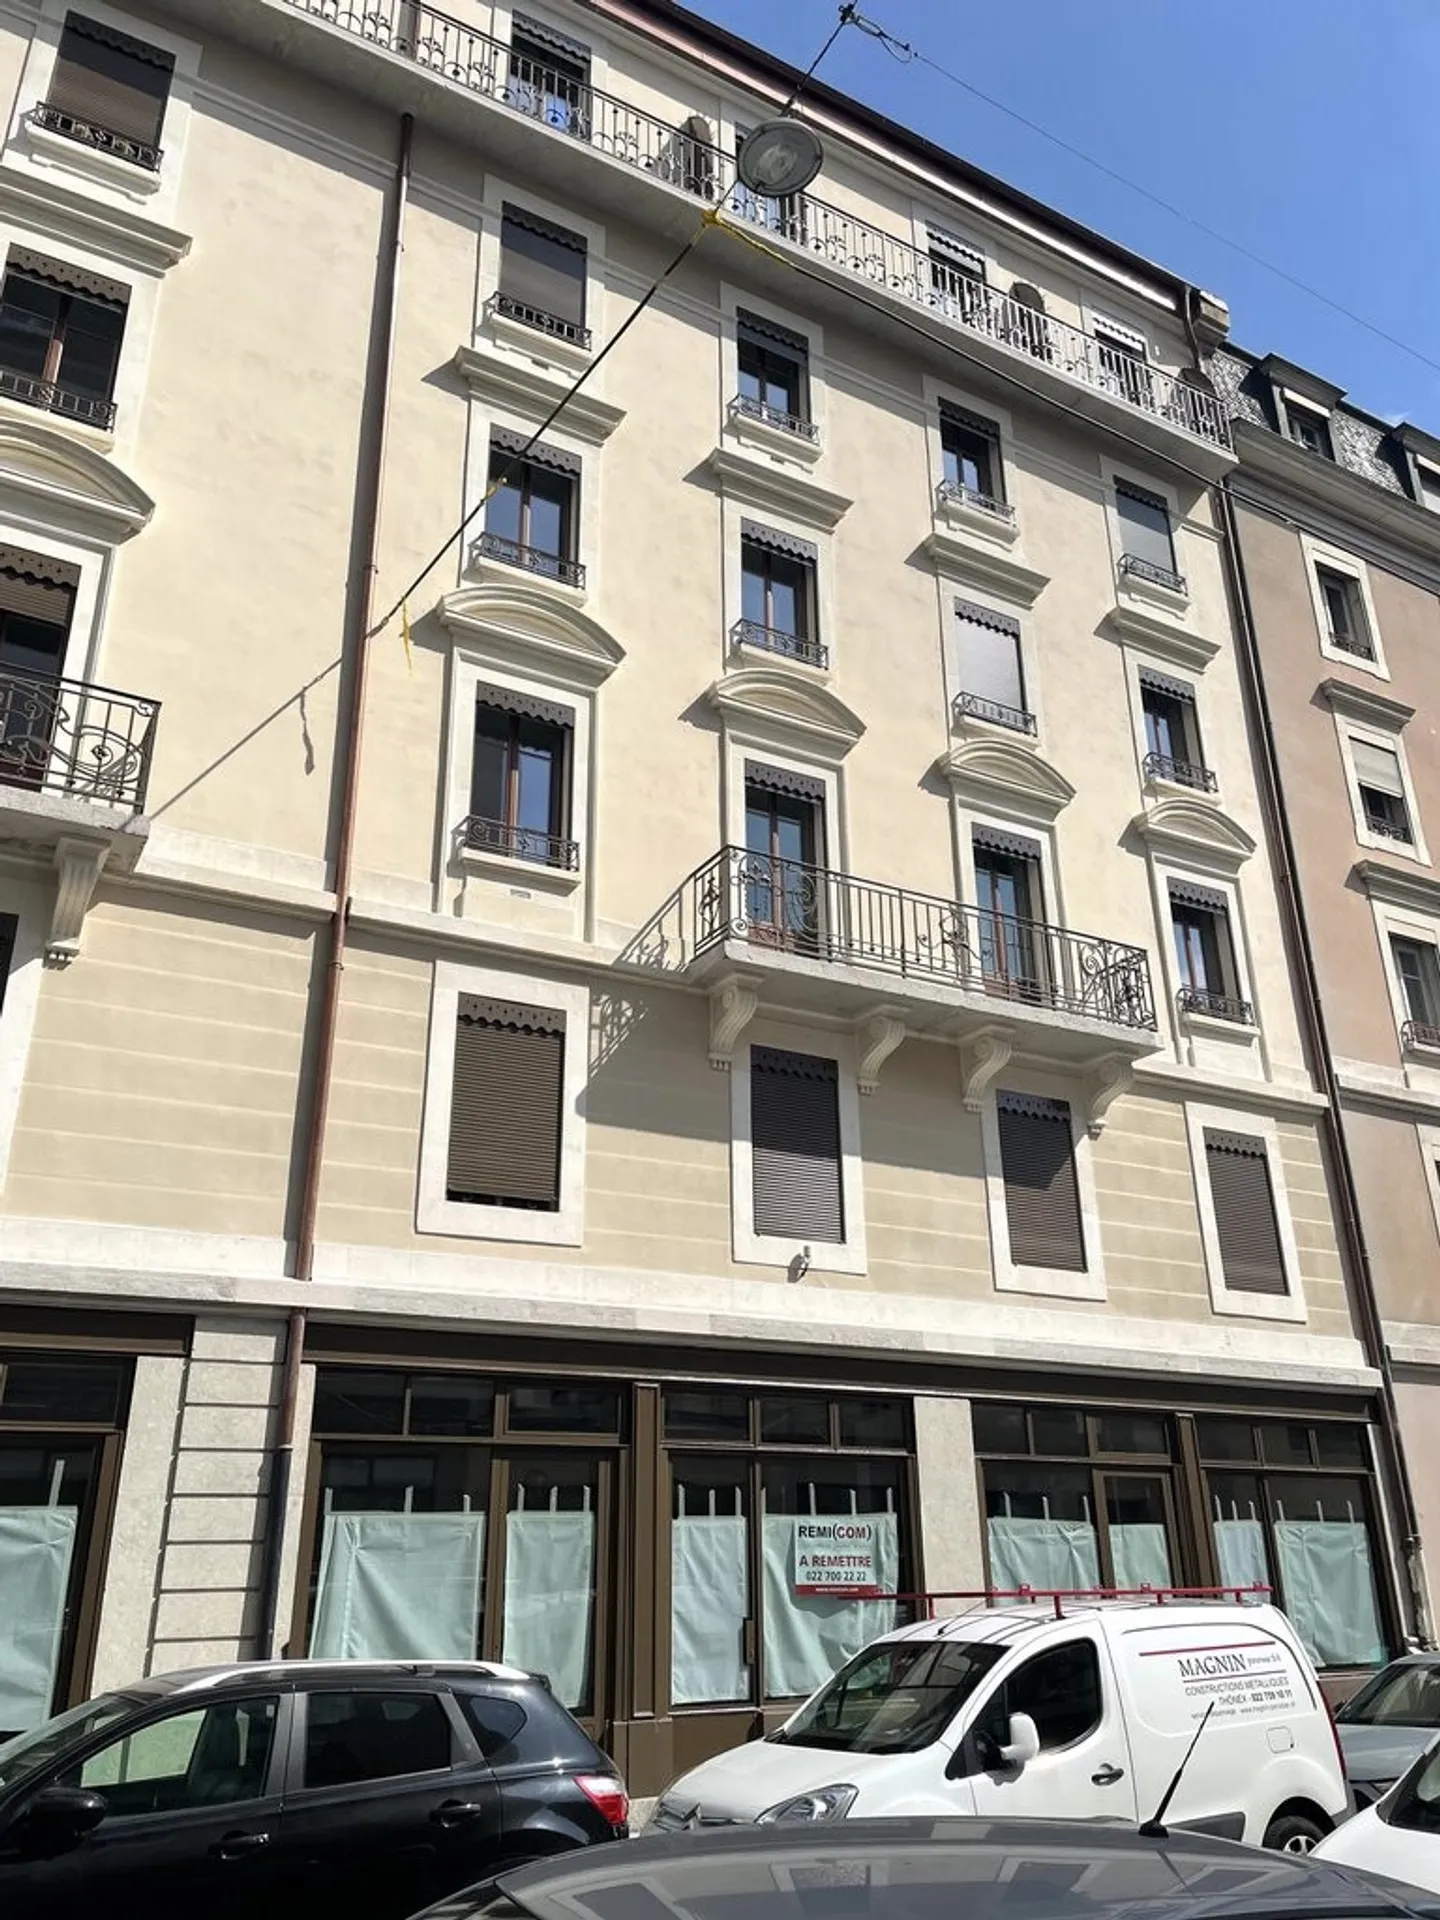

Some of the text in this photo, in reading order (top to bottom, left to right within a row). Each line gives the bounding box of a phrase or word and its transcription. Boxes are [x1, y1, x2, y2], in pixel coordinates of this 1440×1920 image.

[798, 1523, 872, 1541] REMI(COM)
[799, 1555, 872, 1568] A REMETTRE
[806, 1571, 867, 1582] 022 700 22 22
[1177, 1653, 1246, 1677] MAGNIN
